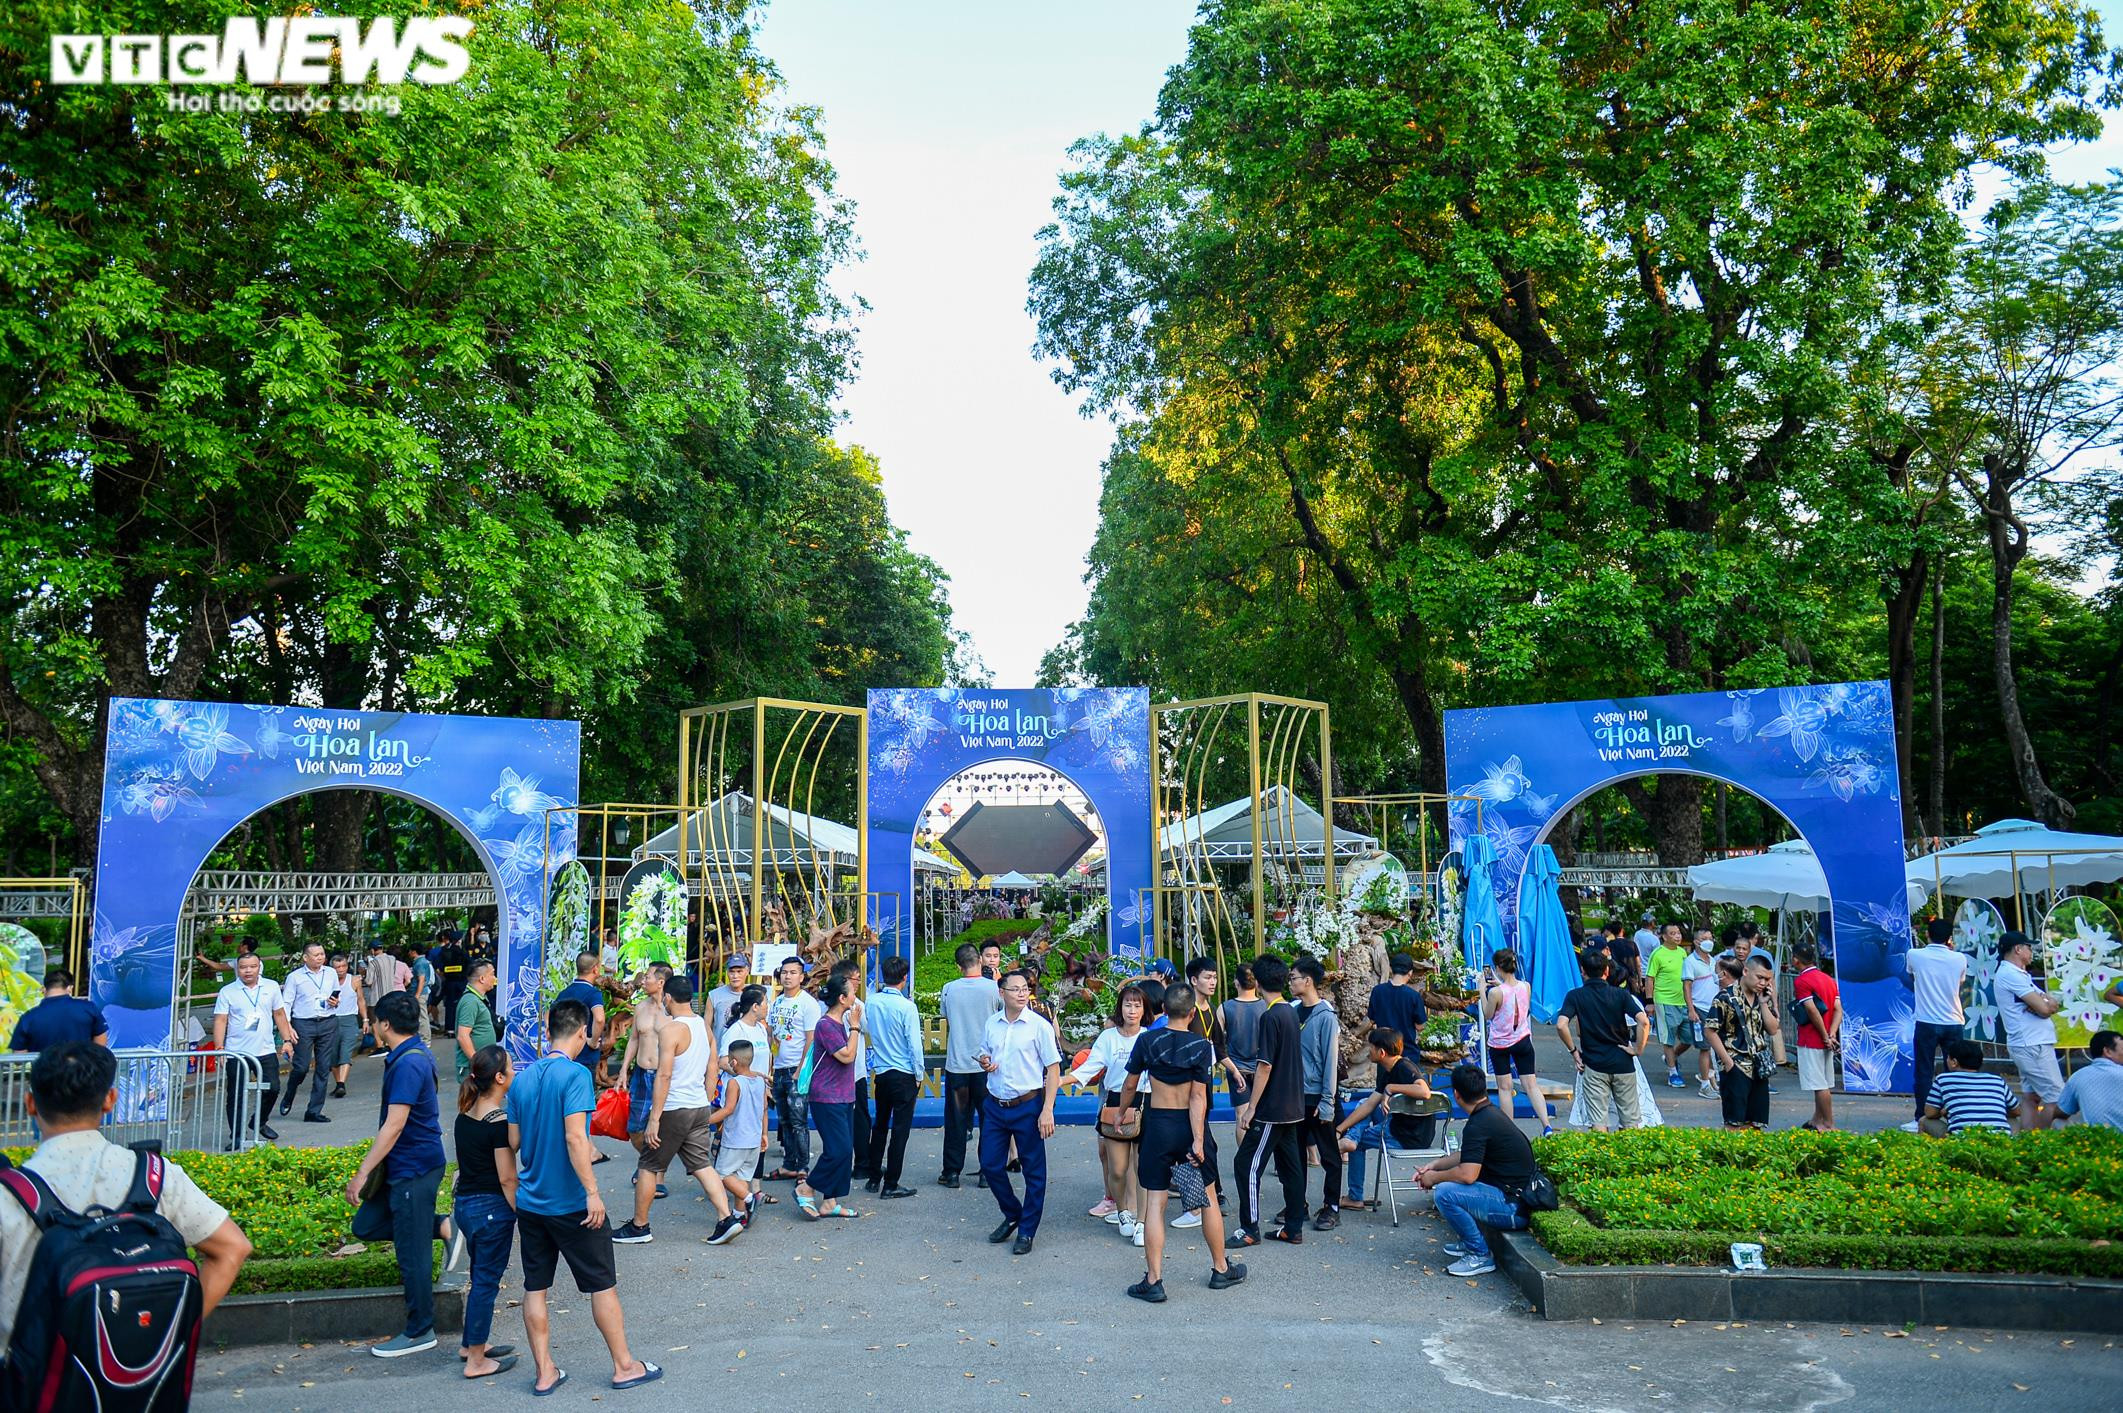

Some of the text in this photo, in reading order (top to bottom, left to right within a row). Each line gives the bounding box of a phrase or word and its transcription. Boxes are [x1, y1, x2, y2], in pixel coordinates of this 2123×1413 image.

[958, 714, 1009, 734] Hoa
[292, 733, 360, 758] Hoa
[986, 735, 1016, 749] Nam
[1016, 735, 1044, 747] 2022
[1594, 726, 1650, 747] Hoa
[1626, 747, 1659, 761] Nam
[1659, 745, 1689, 758] 2022
[328, 759, 367, 778] Nam
[367, 762, 404, 776] 2022
